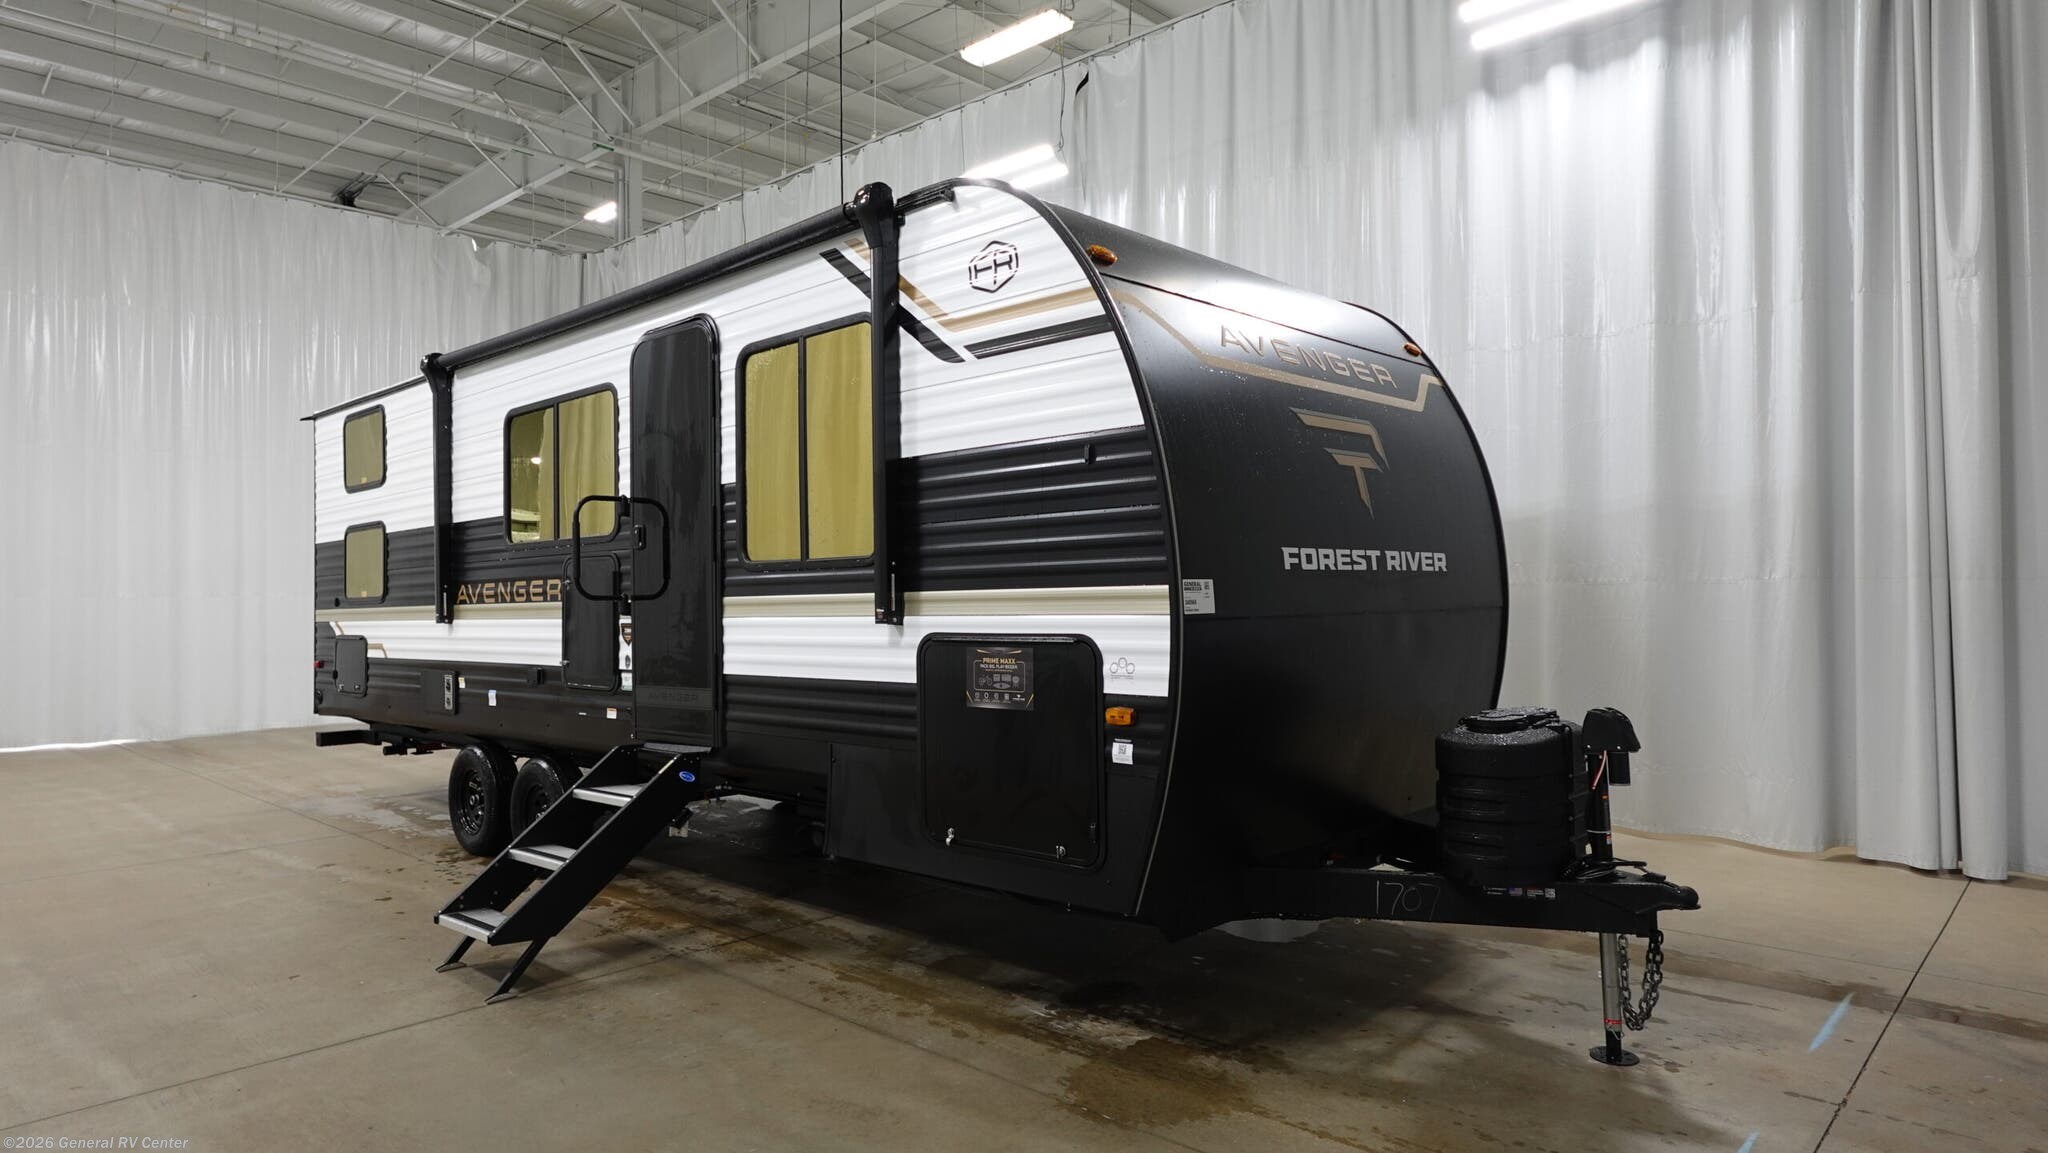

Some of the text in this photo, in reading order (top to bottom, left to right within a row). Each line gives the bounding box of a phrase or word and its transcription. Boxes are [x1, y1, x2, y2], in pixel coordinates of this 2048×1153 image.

[1220, 324, 1398, 389] AVENGER
[1280, 546, 1448, 572] FOREST RIVER
[456, 578, 562, 604] AVENGER
[1376, 879, 1441, 921] 1707
